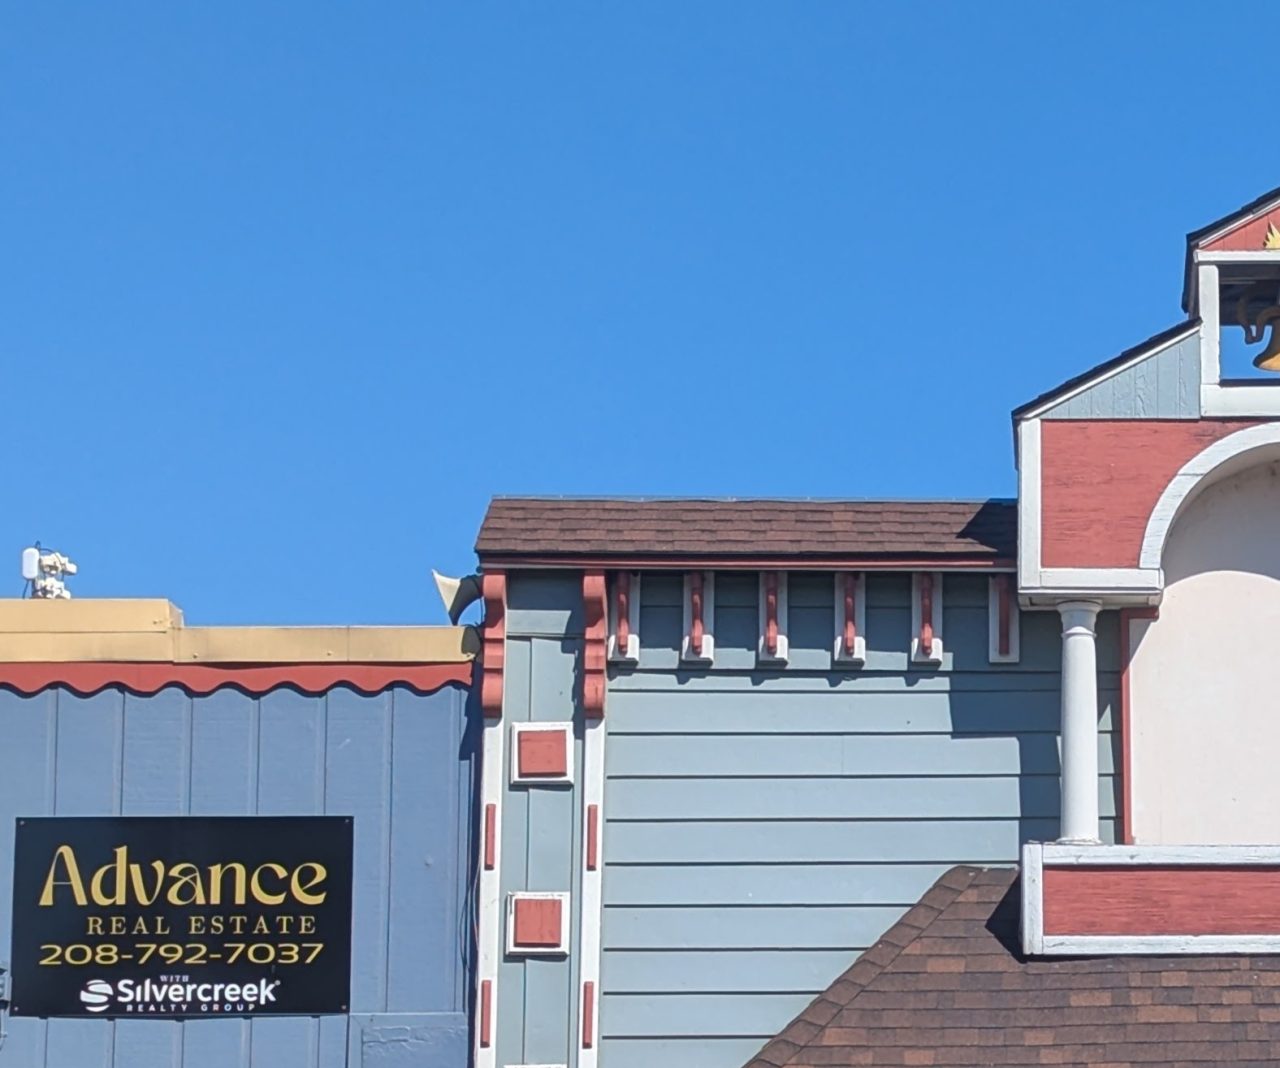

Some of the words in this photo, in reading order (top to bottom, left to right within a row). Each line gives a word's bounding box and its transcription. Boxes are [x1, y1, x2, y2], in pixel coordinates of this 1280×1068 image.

[39, 845, 328, 906] Advance
[87, 916, 171, 935] REAL
[189, 915, 316, 935] ESTATE
[39, 943, 324, 965] 208-792-7037
[159, 975, 190, 983] WITH
[117, 977, 277, 1005] Silvercreek
[126, 1004, 188, 1012] REALTY
[201, 1003, 255, 1012] GROUP
